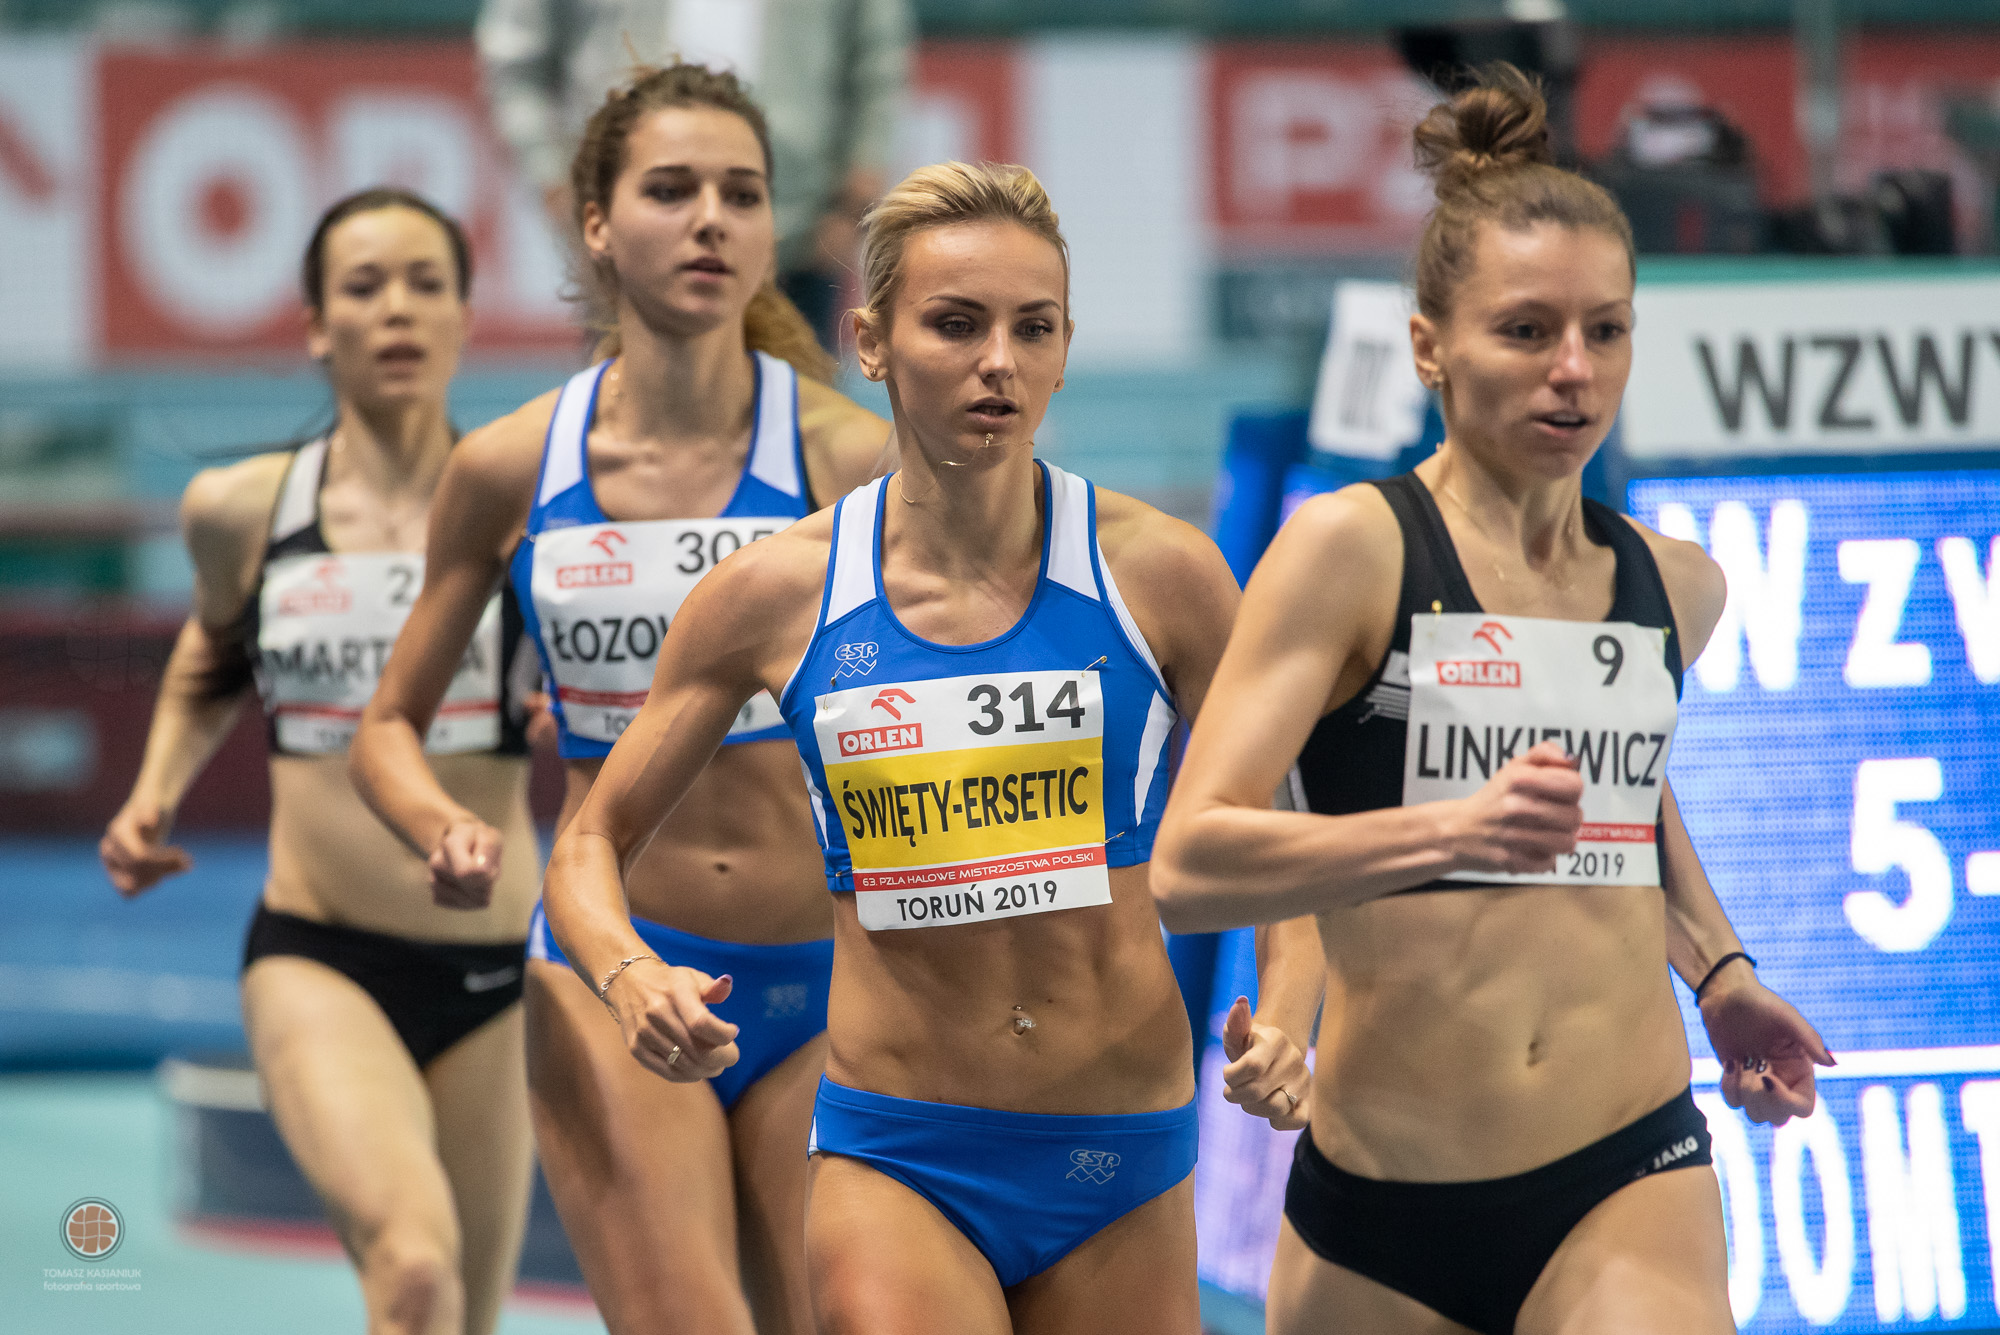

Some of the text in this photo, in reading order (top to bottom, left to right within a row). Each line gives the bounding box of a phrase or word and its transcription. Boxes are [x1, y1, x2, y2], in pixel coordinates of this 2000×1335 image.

[1695, 328, 2000, 432] WZW
[676, 529, 774, 574] 30
[1441, 663, 1517, 685] ORLEN
[1592, 634, 1624, 686] 9
[967, 680, 1085, 736] 314
[842, 727, 918, 753] ORLEN
[842, 766, 1089, 847] ŚWIĘTY-ERSETIC
[862, 852, 1095, 888] 63. PZLA HALOWE MISTRZOSTWA POLSKI
[1568, 852, 1625, 877] 2019
[896, 880, 1058, 921] TORUŃ 2019
